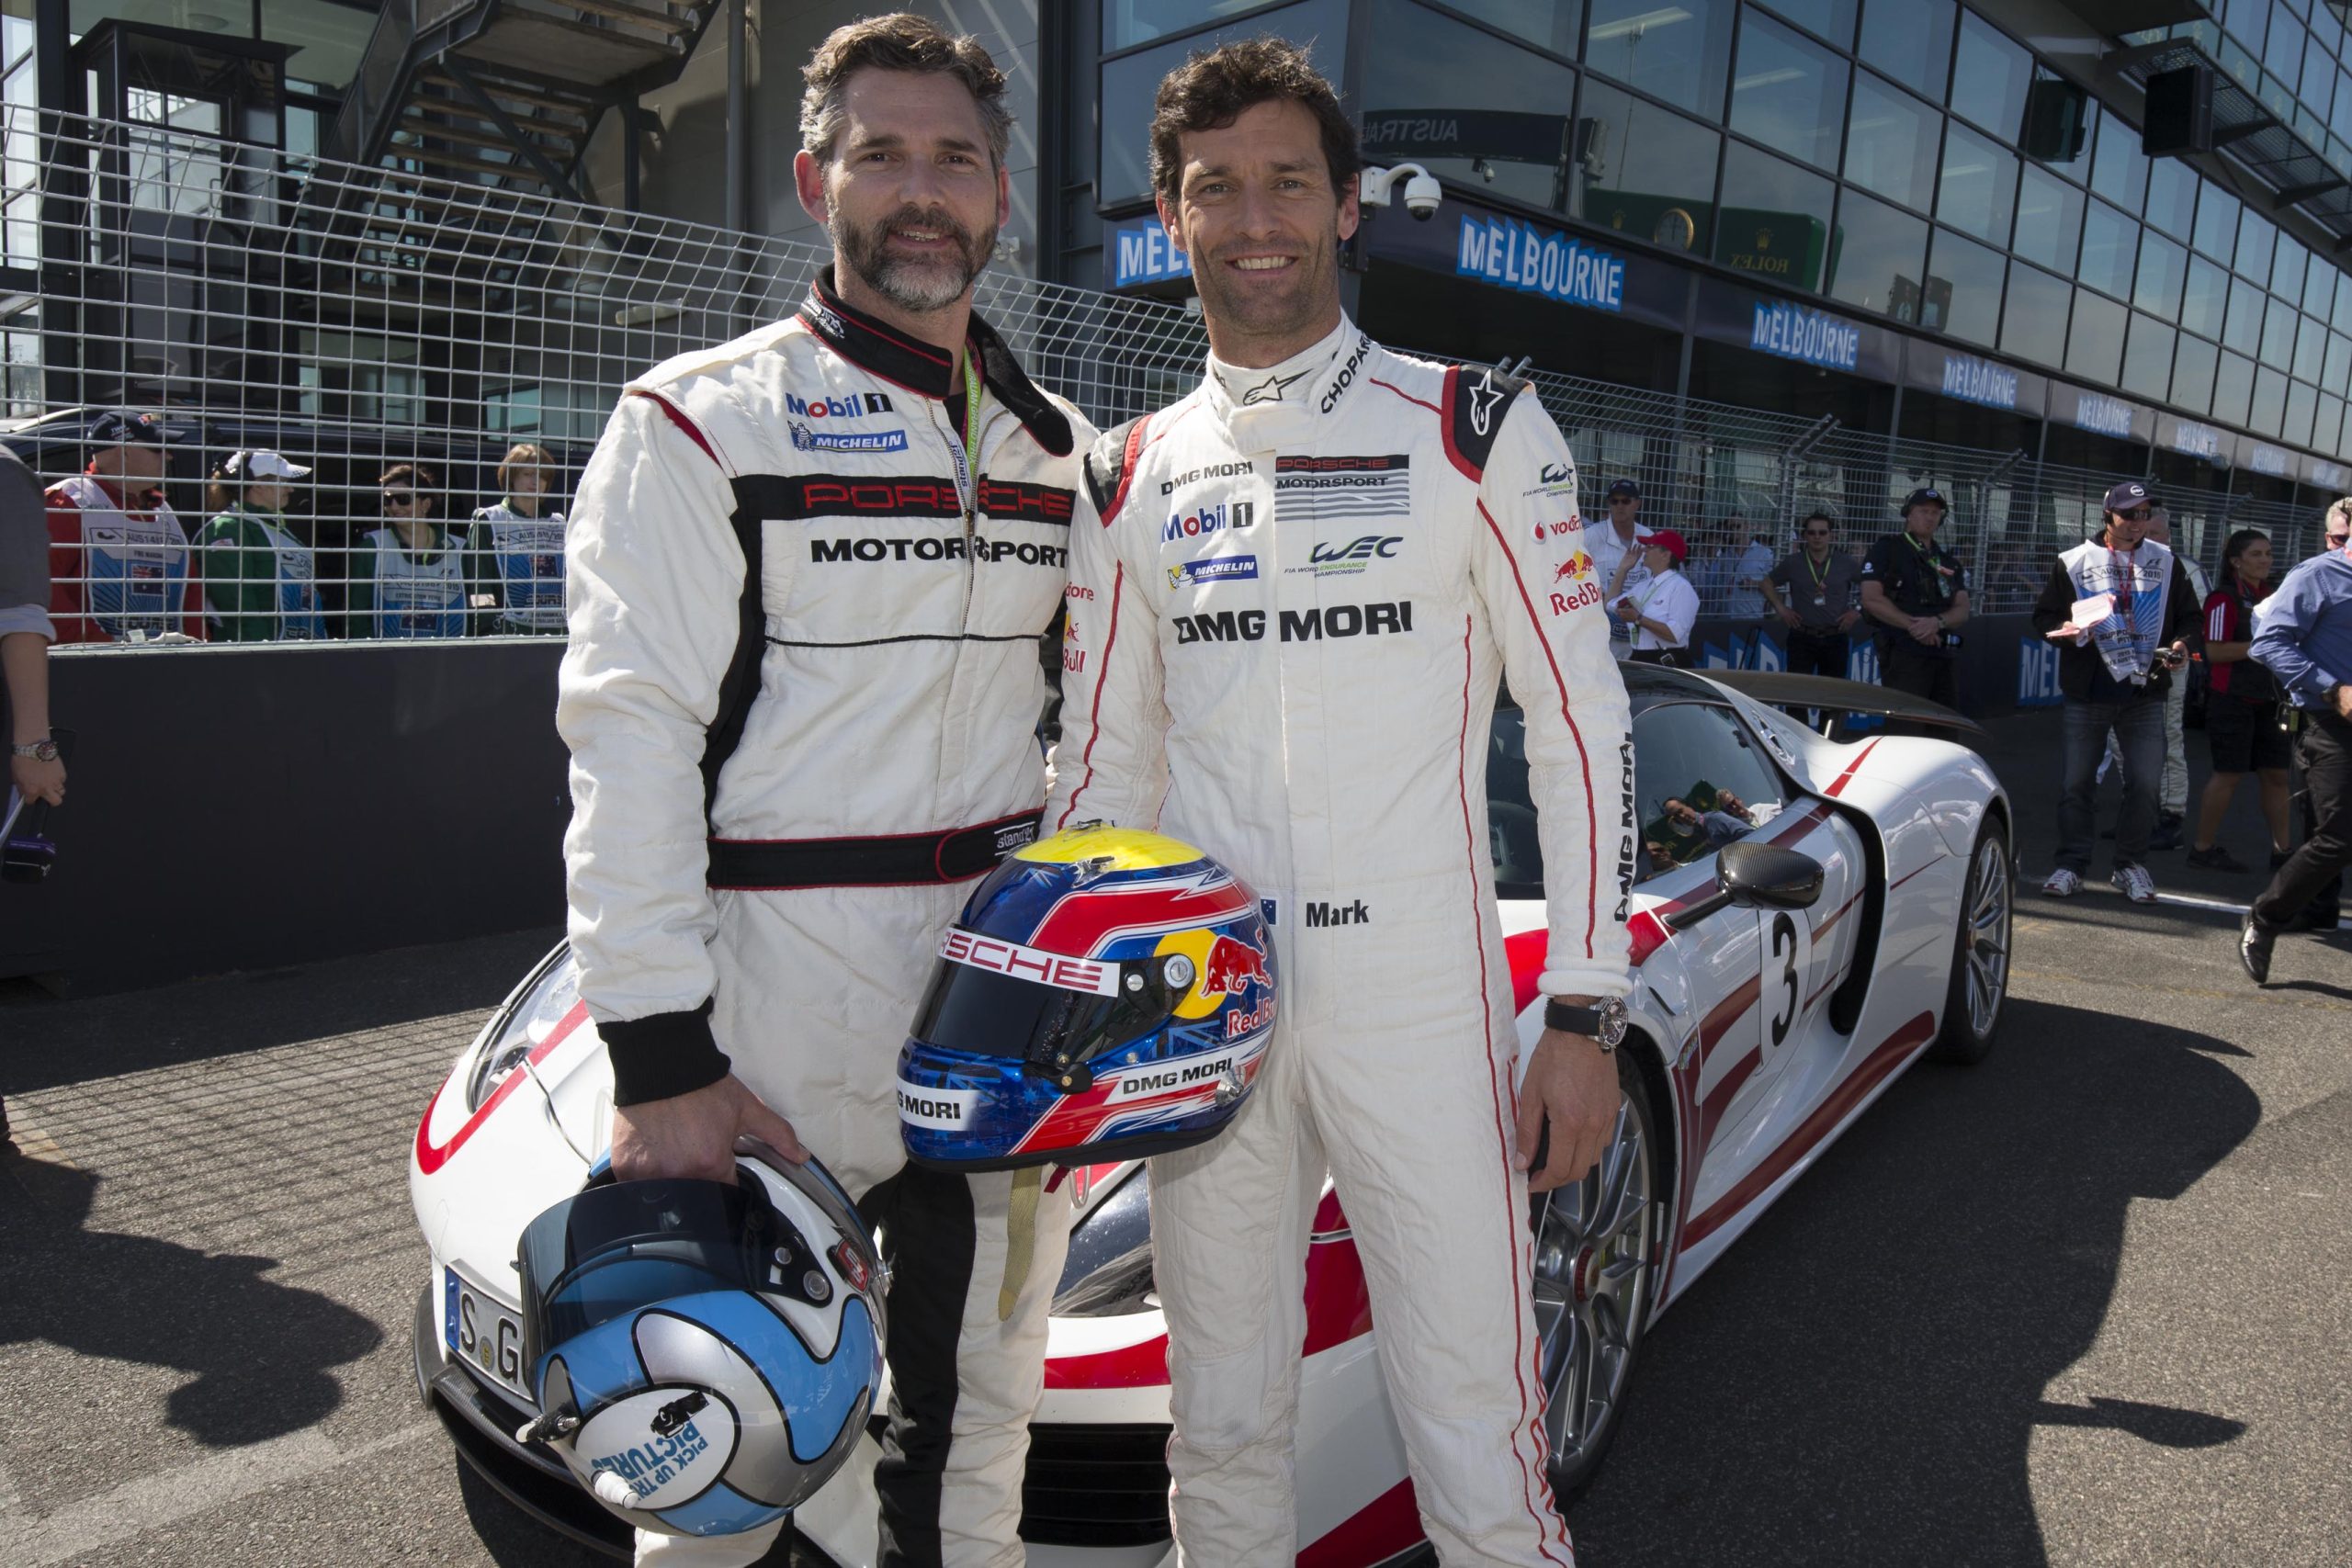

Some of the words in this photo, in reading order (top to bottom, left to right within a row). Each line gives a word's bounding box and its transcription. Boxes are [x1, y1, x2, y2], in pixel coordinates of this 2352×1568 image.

[1120, 227, 1192, 279] MEL
[1462, 223, 1623, 306] MELBOURNE
[1754, 308, 1858, 367] MELBOURNE
[1944, 360, 2016, 407] MELBOURNE
[786, 392, 864, 419] Mobil
[815, 434, 902, 450] MICHELIN
[1161, 469, 1201, 496] DMG
[1204, 461, 1253, 479] MORI
[1277, 458, 1389, 469] PORSCHE
[804, 482, 1071, 517] PORSCHE
[1276, 477, 1389, 490] MOTORSPORT
[1161, 504, 1227, 543] Mobil
[1236, 503, 1251, 528] 1
[810, 537, 1069, 568] MOTORSPORT
[1308, 536, 1404, 563] WEC
[1319, 561, 1367, 571] ENDURANCE
[1194, 561, 1256, 577] MICHELIN
[1314, 568, 1365, 578] HAMPIONSHIP
[1549, 583, 1590, 616] Red
[1172, 610, 1266, 644] DMG
[1279, 601, 1413, 642] MORI
[2021, 640, 2064, 699] MEL
[1614, 835, 1634, 922] DMG
[1306, 899, 1370, 928] Mark
[942, 931, 1103, 991] SCHE
[1770, 911, 1799, 1047] 3
[1227, 999, 1262, 1039] Red
[1123, 1071, 1178, 1095] DMG
[1182, 1057, 1233, 1083] MORI
[905, 1094, 961, 1120] MORI
[460, 1292, 477, 1354] S
[672, 1436, 709, 1471] PICK
[654, 1464, 677, 1485] UP
